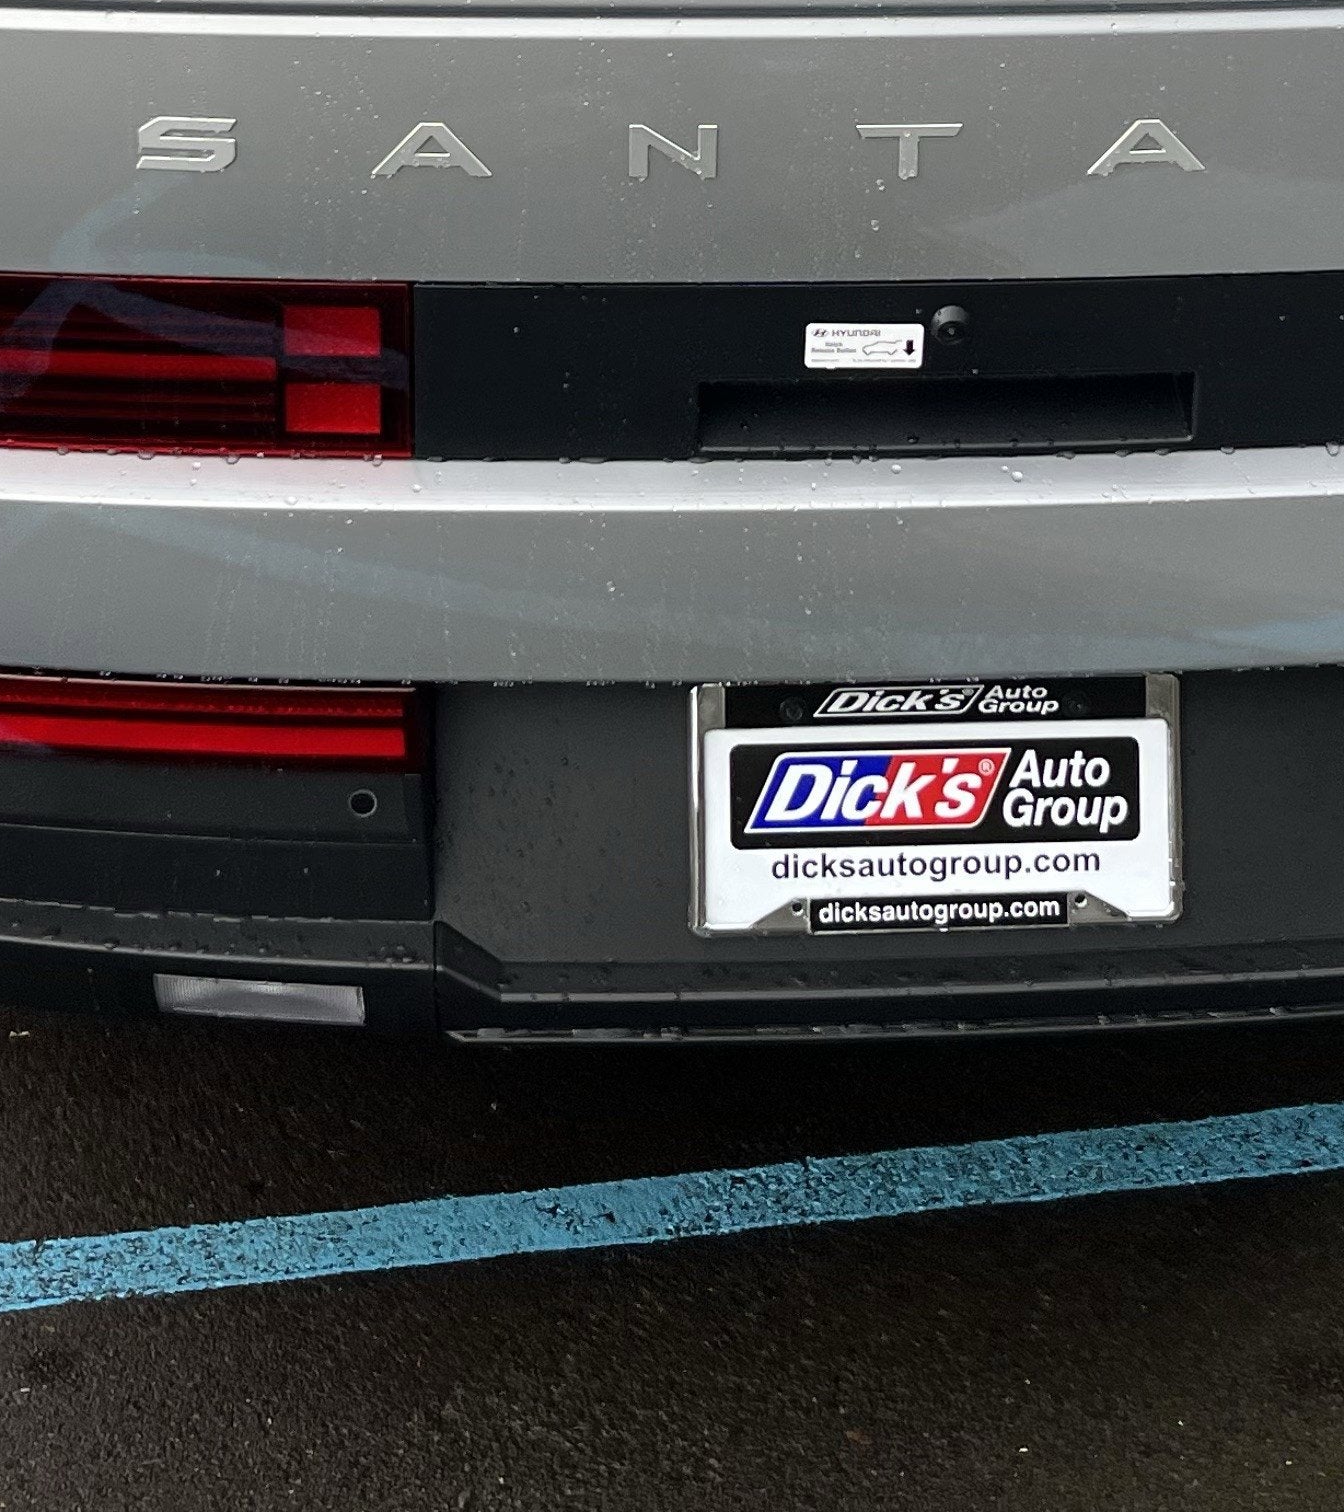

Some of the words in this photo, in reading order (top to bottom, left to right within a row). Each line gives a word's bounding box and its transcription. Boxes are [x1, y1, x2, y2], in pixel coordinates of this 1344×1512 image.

[135, 116, 1206, 178] SANTA
[831, 328, 882, 337] HYUNDAI
[978, 698, 1060, 716] Group
[984, 685, 1048, 700] Auto
[1009, 748, 1111, 789] Auto
[1002, 790, 1129, 833] Group
[771, 849, 1101, 883] dicksautogroup.com
[818, 898, 1061, 925] dicksautogroup.com
